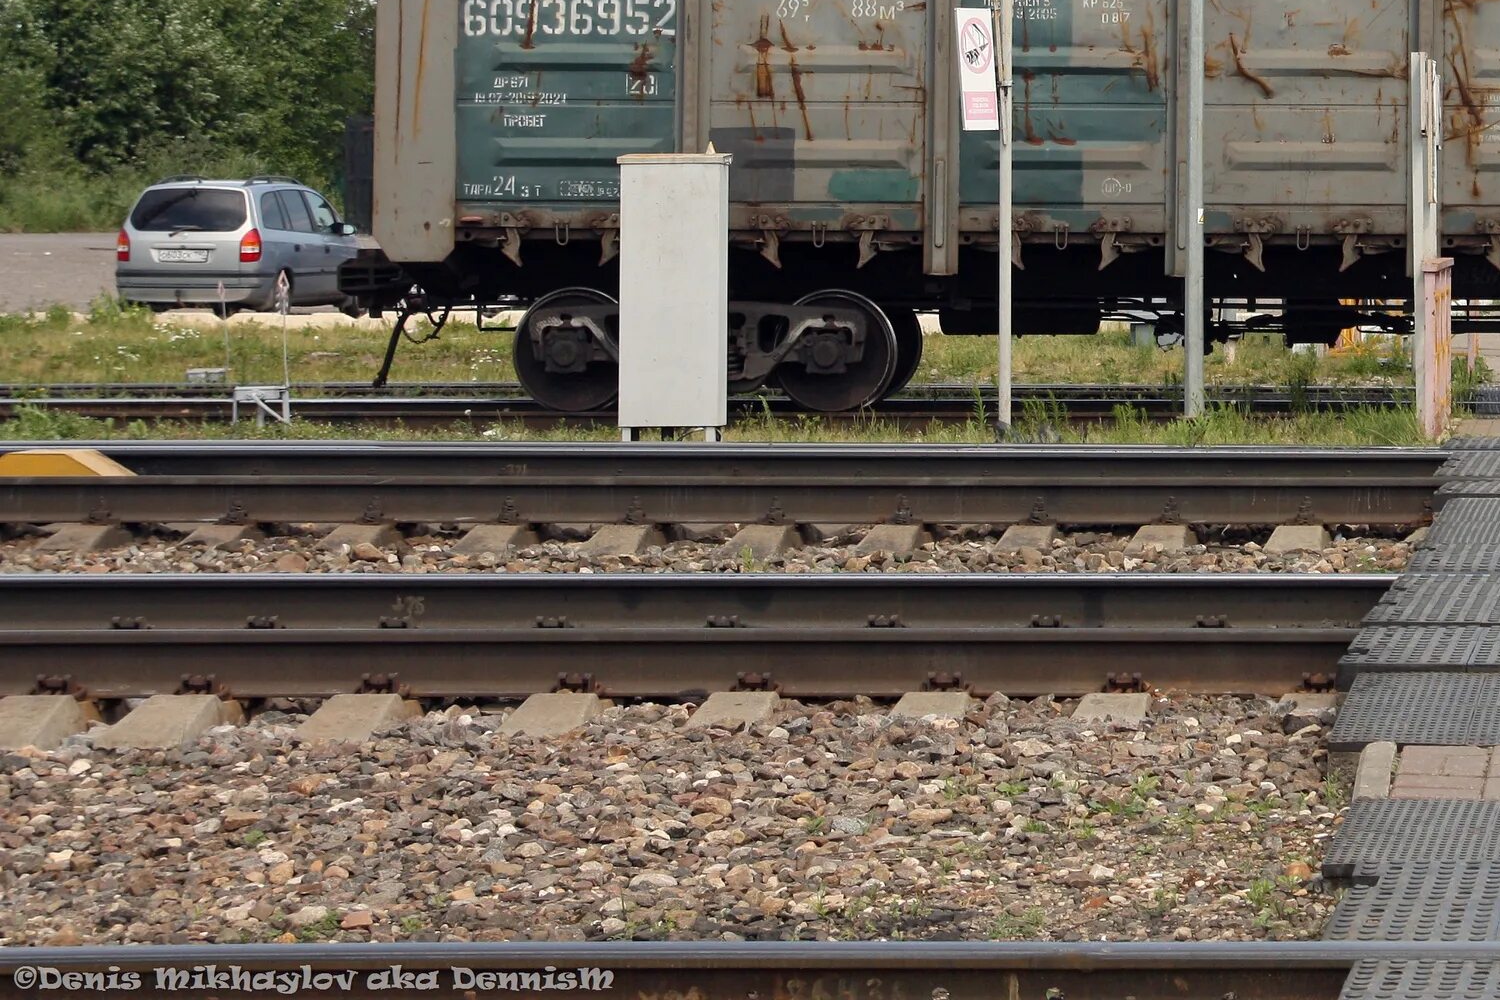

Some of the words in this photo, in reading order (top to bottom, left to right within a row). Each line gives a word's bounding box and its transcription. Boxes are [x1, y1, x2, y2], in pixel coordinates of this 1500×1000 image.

[504, 114, 546, 127] ПРОБЕГ
[464, 183, 491, 196] ТАРА
[493, 176, 515, 196] 24
